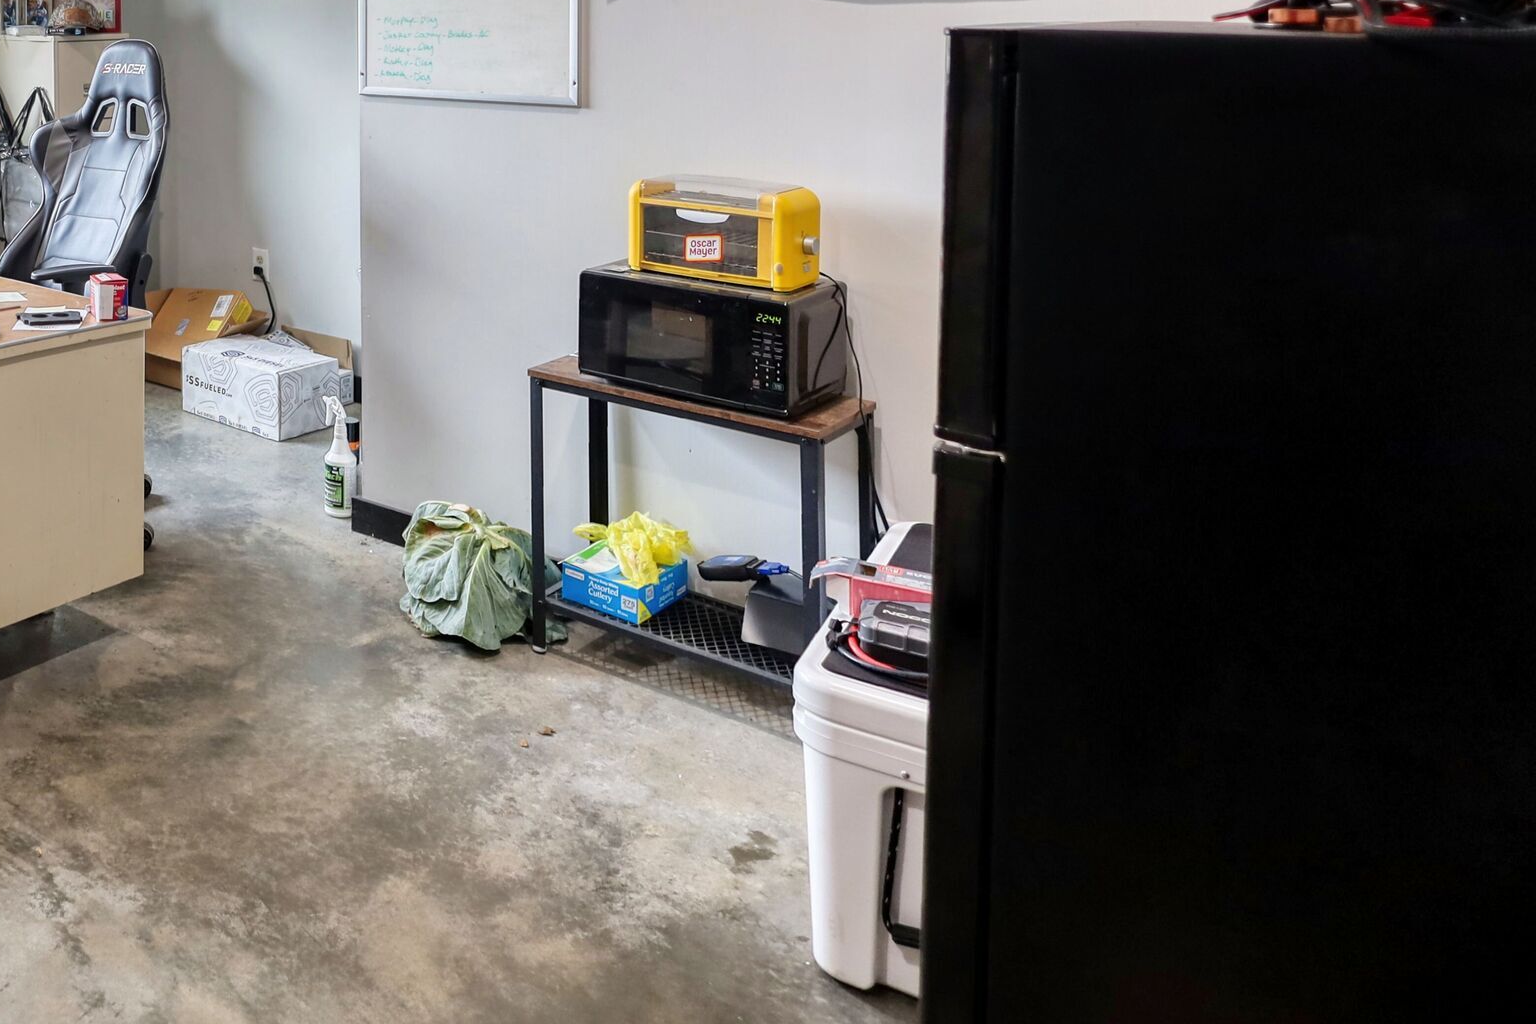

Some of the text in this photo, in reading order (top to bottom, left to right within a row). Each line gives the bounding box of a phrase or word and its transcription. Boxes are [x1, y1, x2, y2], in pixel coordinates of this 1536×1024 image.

[690, 239, 717, 248] Oscar
[689, 247, 717, 258] Mayer
[588, 580, 619, 597] Assorted
[588, 588, 613, 604] Cutlery
